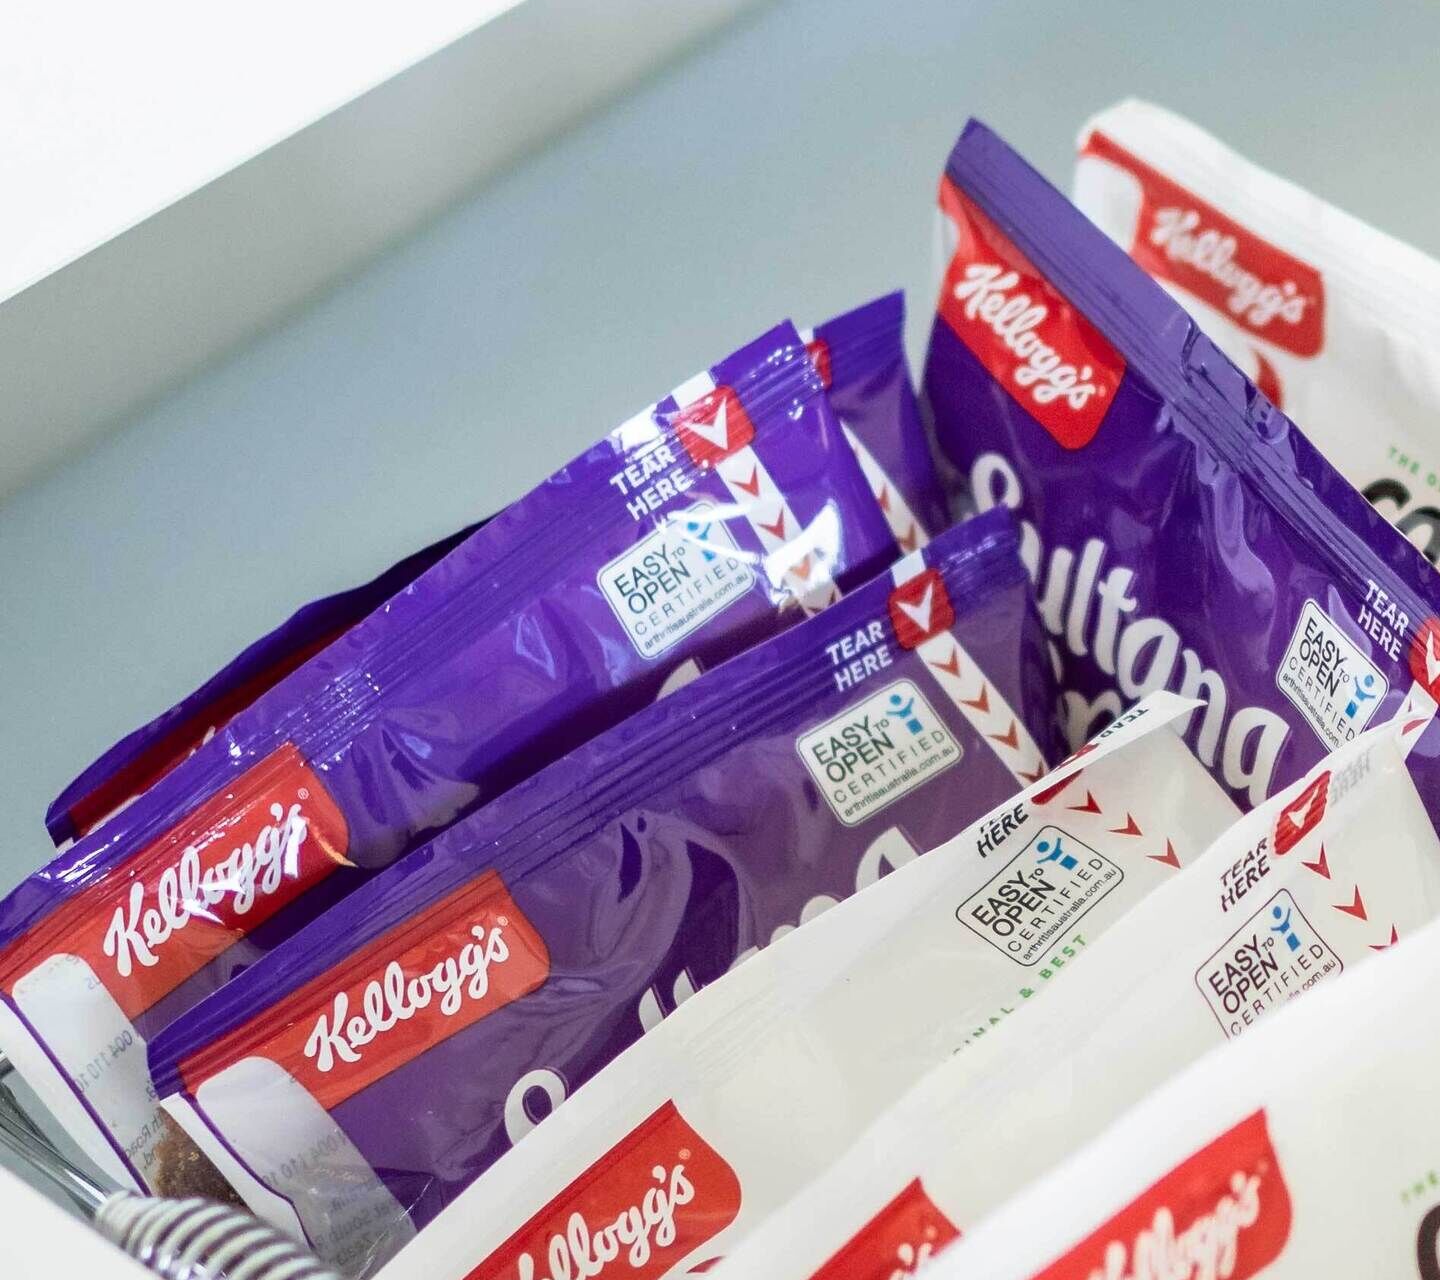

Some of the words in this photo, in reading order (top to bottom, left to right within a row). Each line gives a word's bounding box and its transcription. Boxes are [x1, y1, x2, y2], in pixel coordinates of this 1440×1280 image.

[1150, 206, 1304, 326] Kellogg's
[952, 263, 1097, 409] Kellogg's
[609, 445, 678, 496] TEAR
[626, 467, 695, 522] HERE
[613, 543, 672, 598] EASY
[671, 546, 687, 564] TO
[627, 559, 692, 615] OPEN
[634, 556, 739, 636] CERTIFIED
[1357, 604, 1404, 663] HERE
[1365, 578, 1410, 638] TEAR
[825, 620, 885, 666] TEAR
[833, 644, 894, 693] HERE
[1299, 638, 1341, 698] OPEN
[1304, 616, 1349, 669] EASY
[1339, 669, 1351, 684] TO
[1288, 656, 1356, 742] CERTIFIED
[811, 714, 873, 766] EASY
[873, 718, 890, 733] TO
[825, 731, 895, 782] OPEN
[833, 729, 946, 804] CERTIFIED
[977, 802, 1030, 859] HERE
[103, 802, 307, 977] Kellogg's
[1219, 837, 1269, 887] TEAR
[1220, 855, 1271, 913] HERE
[971, 869, 1031, 927] EASY
[1028, 867, 1044, 884] TO
[991, 878, 1057, 938] OPEN
[1007, 858, 1104, 953] CERTIFIED
[1039, 934, 1087, 980] BEST
[1208, 934, 1262, 997] EASY
[1262, 936, 1275, 952] TO
[1222, 951, 1279, 1014] OPEN
[303, 923, 512, 1073] Kellogg's
[1230, 942, 1325, 1037] CERTIFIED
[1400, 1168, 1440, 1206] THE
